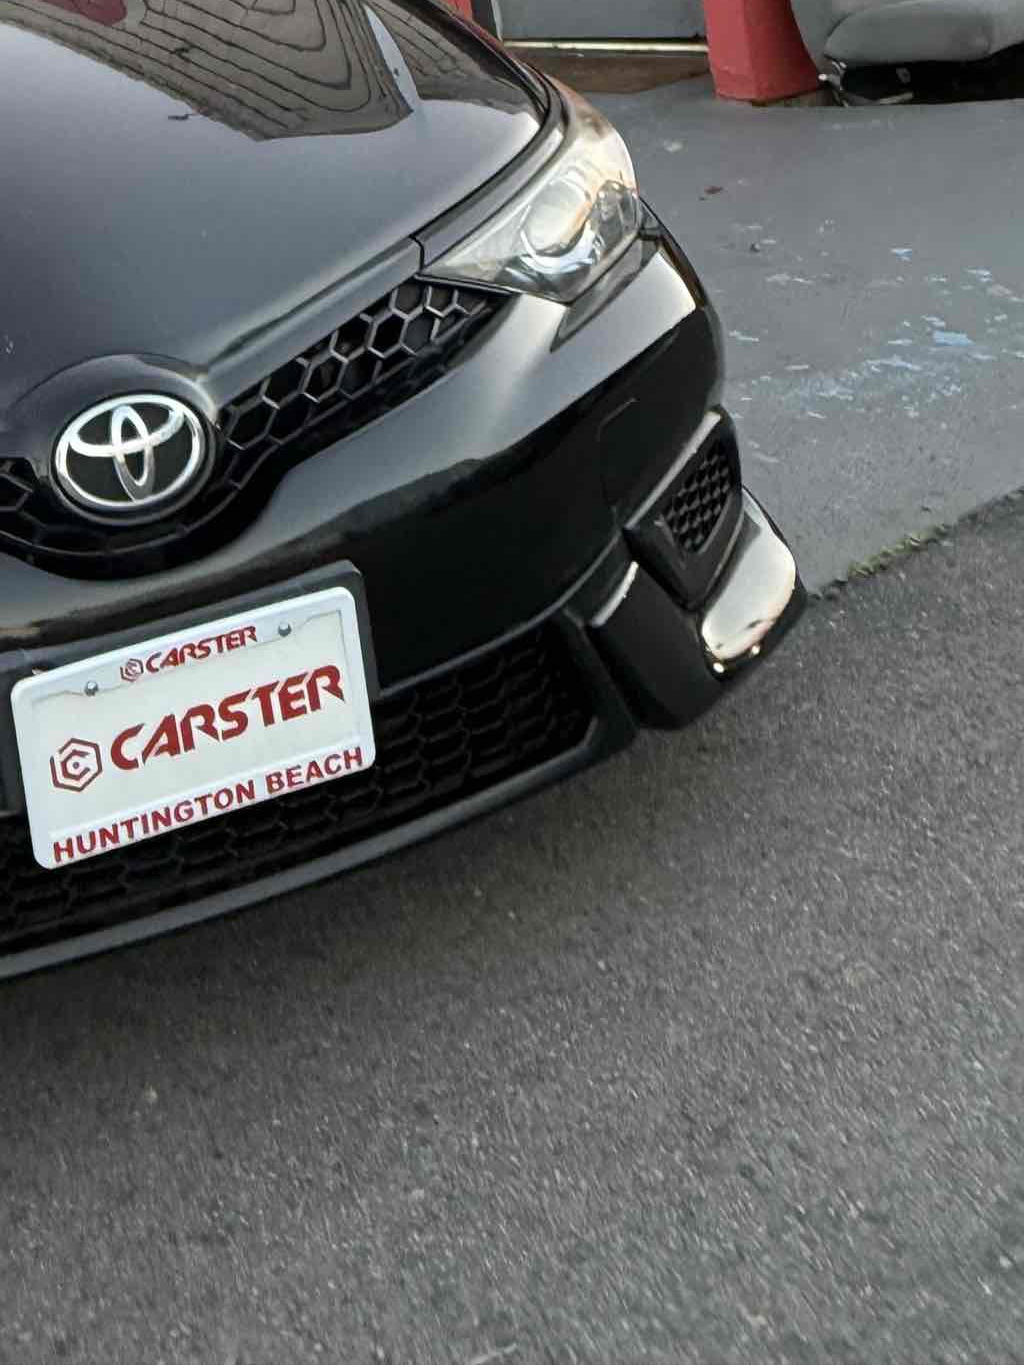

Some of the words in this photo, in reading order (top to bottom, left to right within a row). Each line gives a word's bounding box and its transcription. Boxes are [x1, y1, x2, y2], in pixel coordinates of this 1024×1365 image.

[145, 625, 257, 673] CARSTER
[110, 664, 345, 770] CARSTER
[53, 779, 255, 863] HUNTINGTON
[264, 746, 363, 795] BEACH
